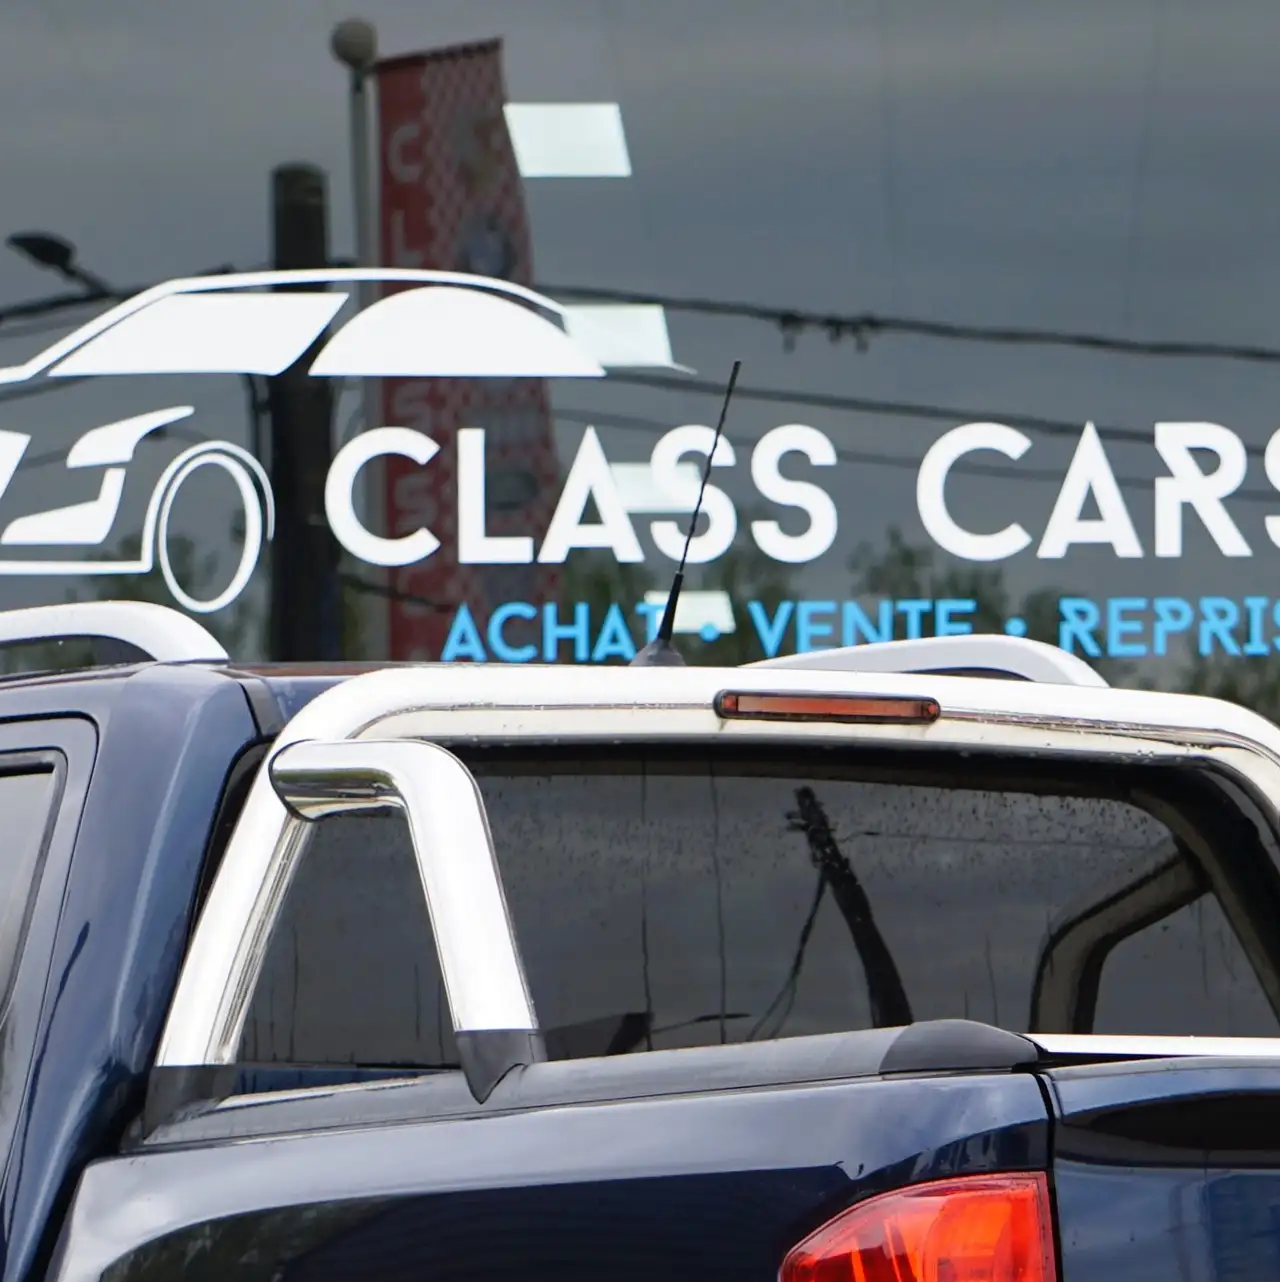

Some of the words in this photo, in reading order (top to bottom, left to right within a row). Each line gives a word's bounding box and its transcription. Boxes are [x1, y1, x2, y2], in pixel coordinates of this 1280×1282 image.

[324, 424, 838, 565] CLASS
[441, 602, 669, 663] ACHAT
[747, 600, 977, 658] VENTE
